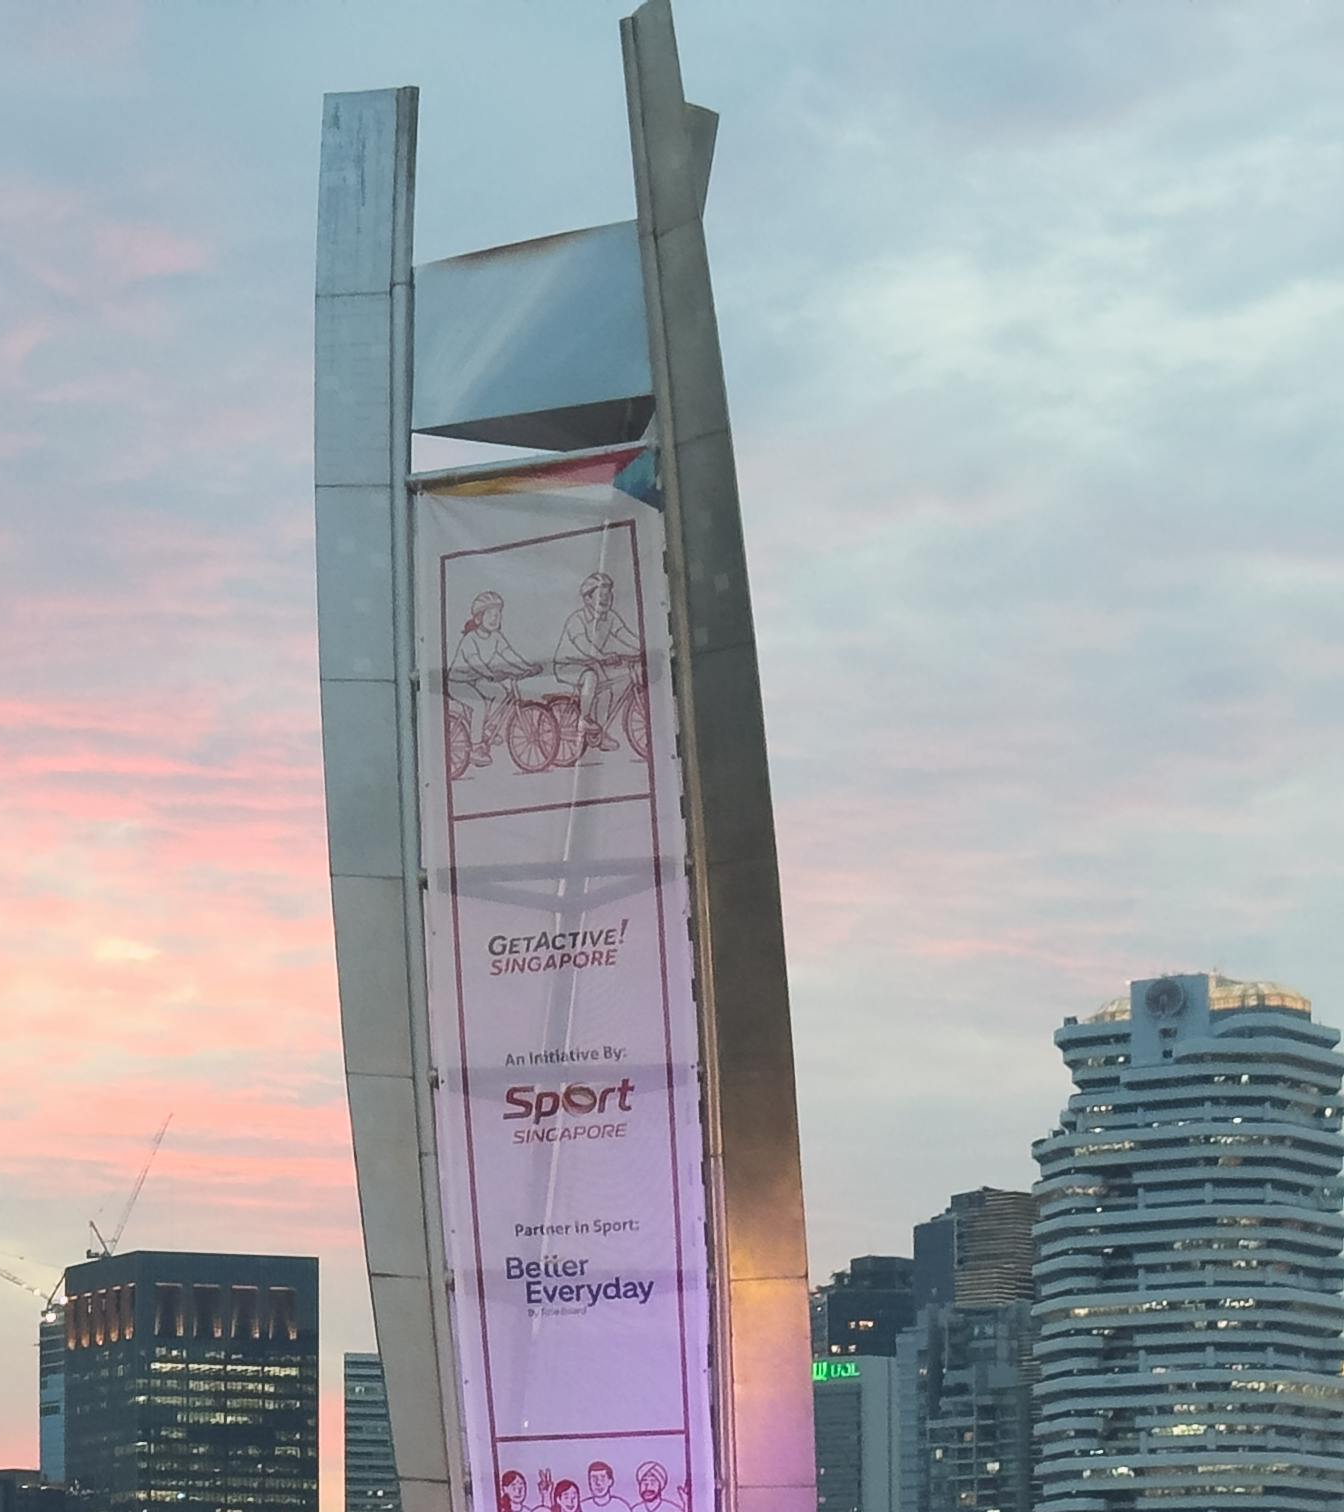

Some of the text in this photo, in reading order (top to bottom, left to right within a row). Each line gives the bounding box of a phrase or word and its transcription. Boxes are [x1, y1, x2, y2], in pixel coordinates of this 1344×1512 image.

[490, 949, 618, 976] SINGAPORE
[505, 1053, 525, 1067] An
[502, 1078, 635, 1125] Sport
[512, 1123, 628, 1145] SINGAPORE
[515, 1219, 640, 1237] Partner in Sport:
[526, 1276, 654, 1307] Everyday
